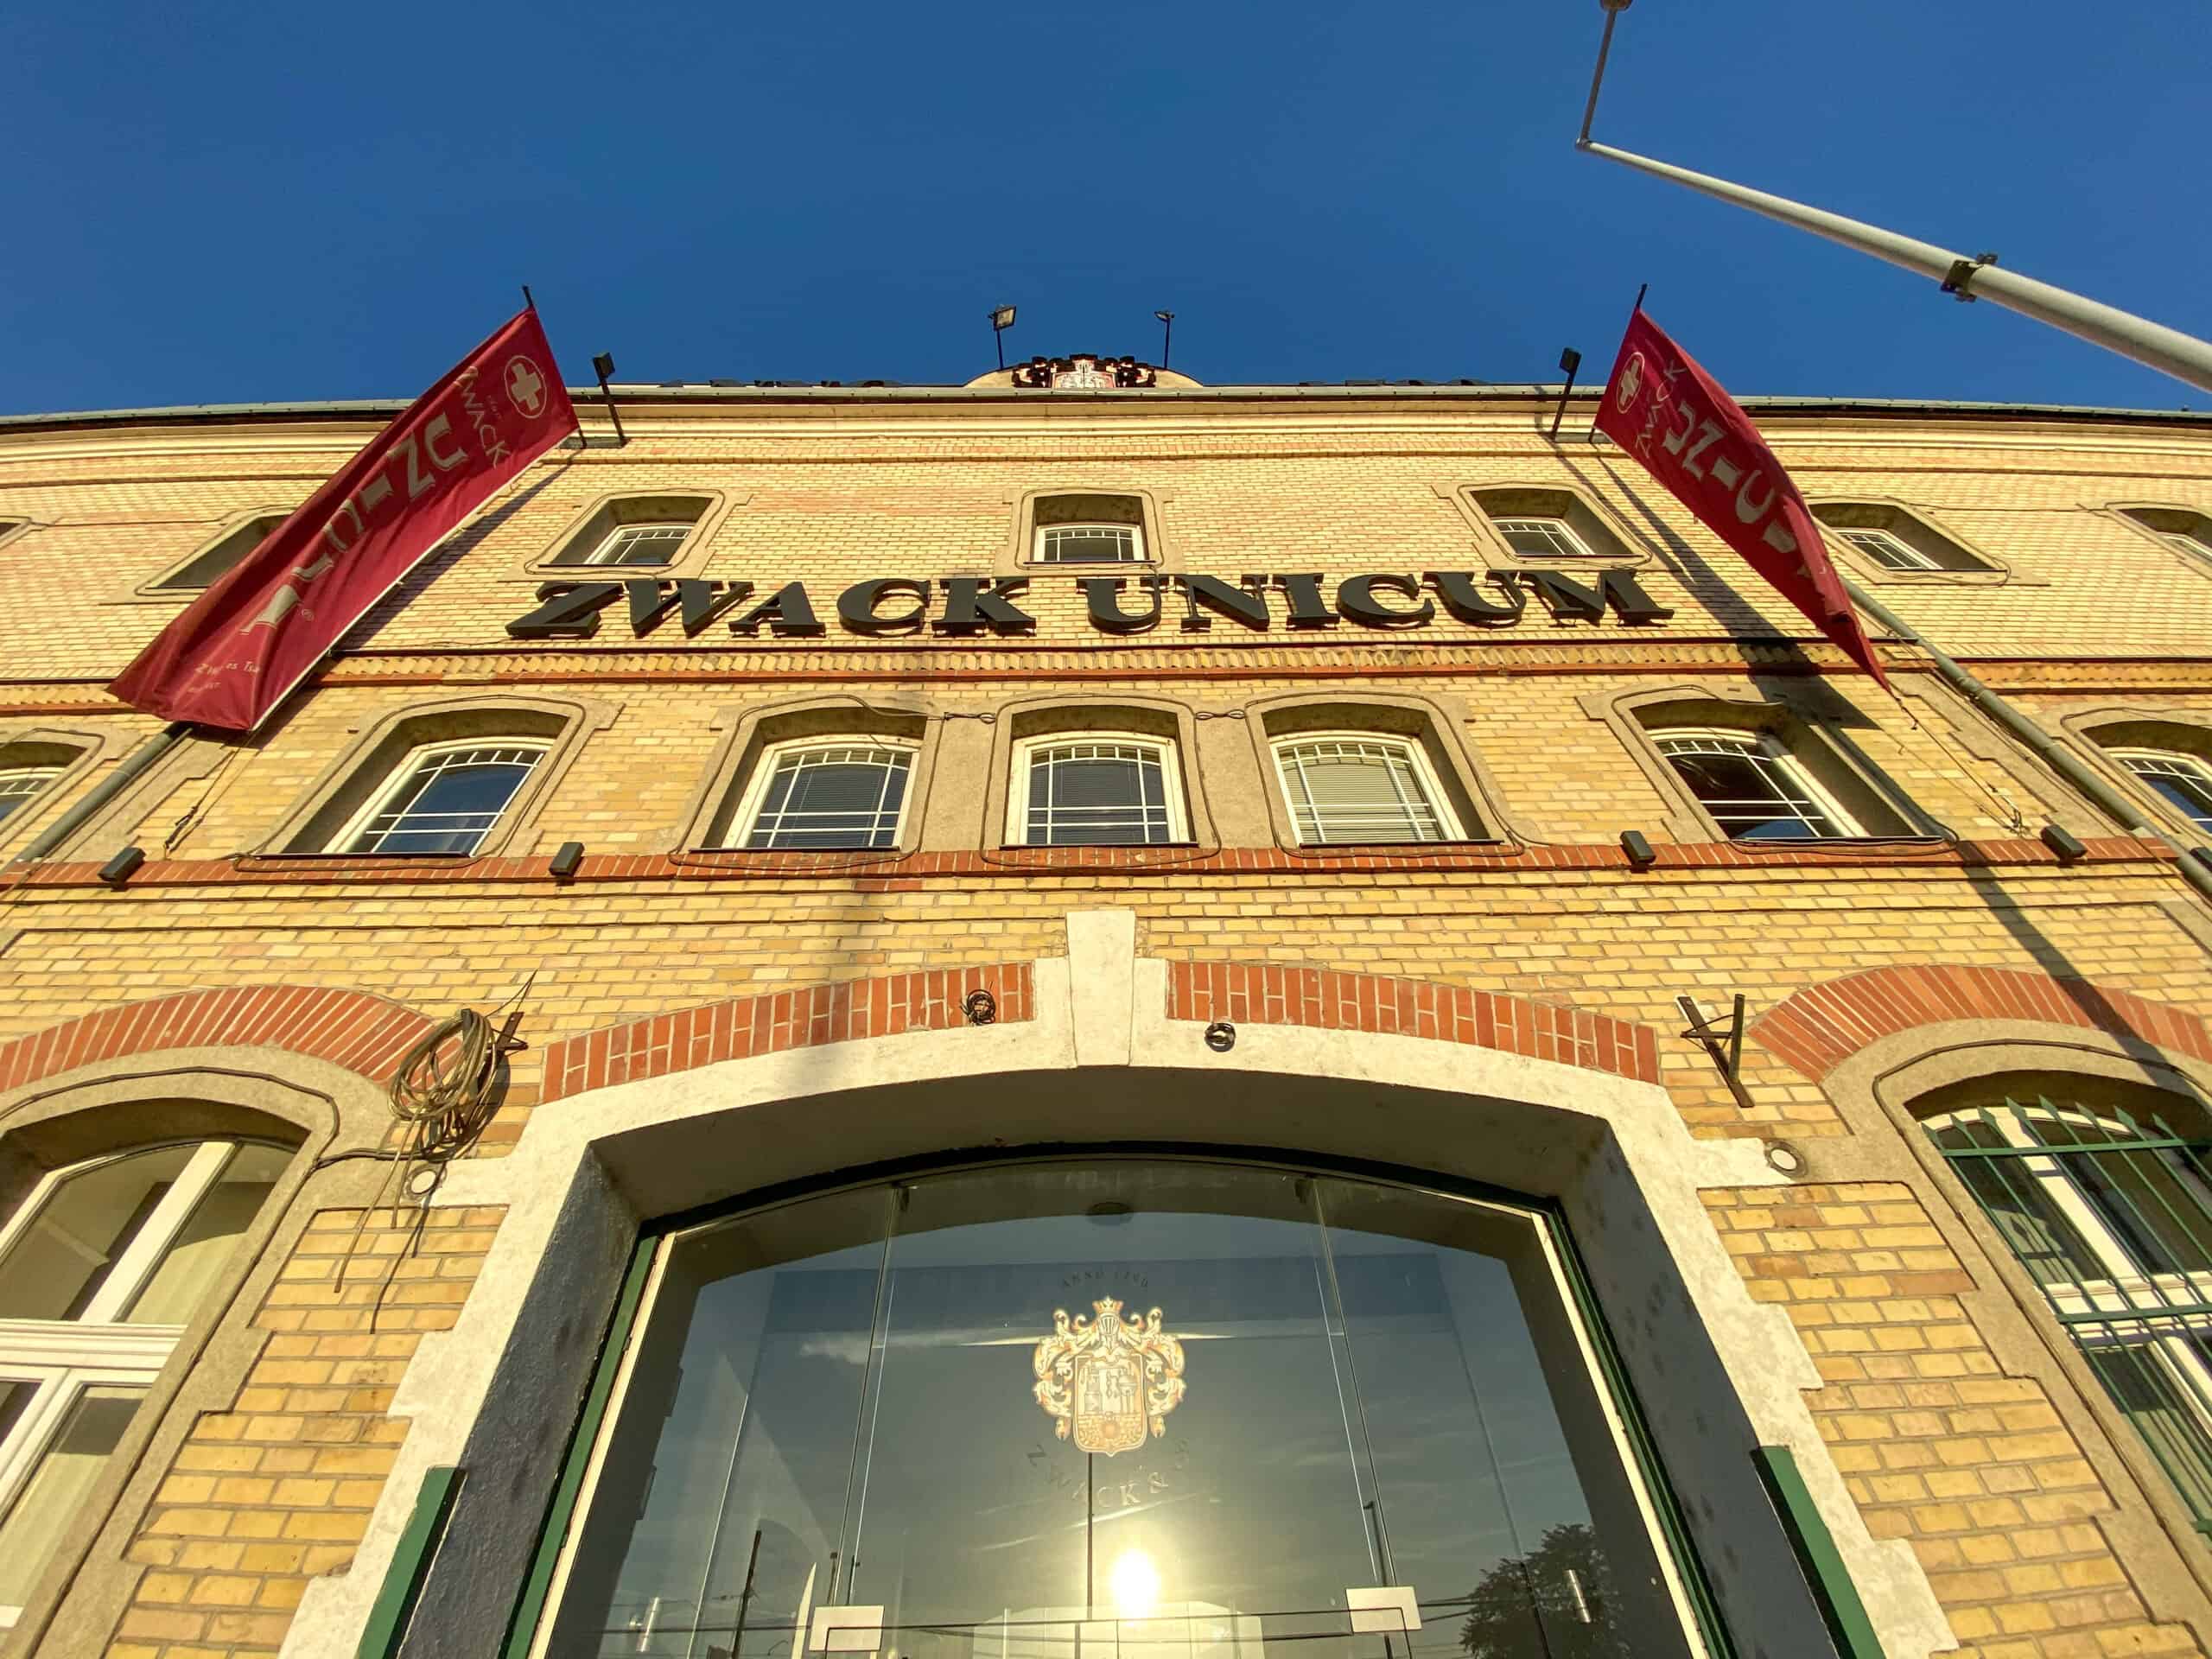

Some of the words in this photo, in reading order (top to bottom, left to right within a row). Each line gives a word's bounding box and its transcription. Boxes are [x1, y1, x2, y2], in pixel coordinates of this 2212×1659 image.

[1662, 400, 1814, 580] UNIC
[505, 578, 1037, 640] ZWACK
[1076, 569, 1675, 632] UNICUM
